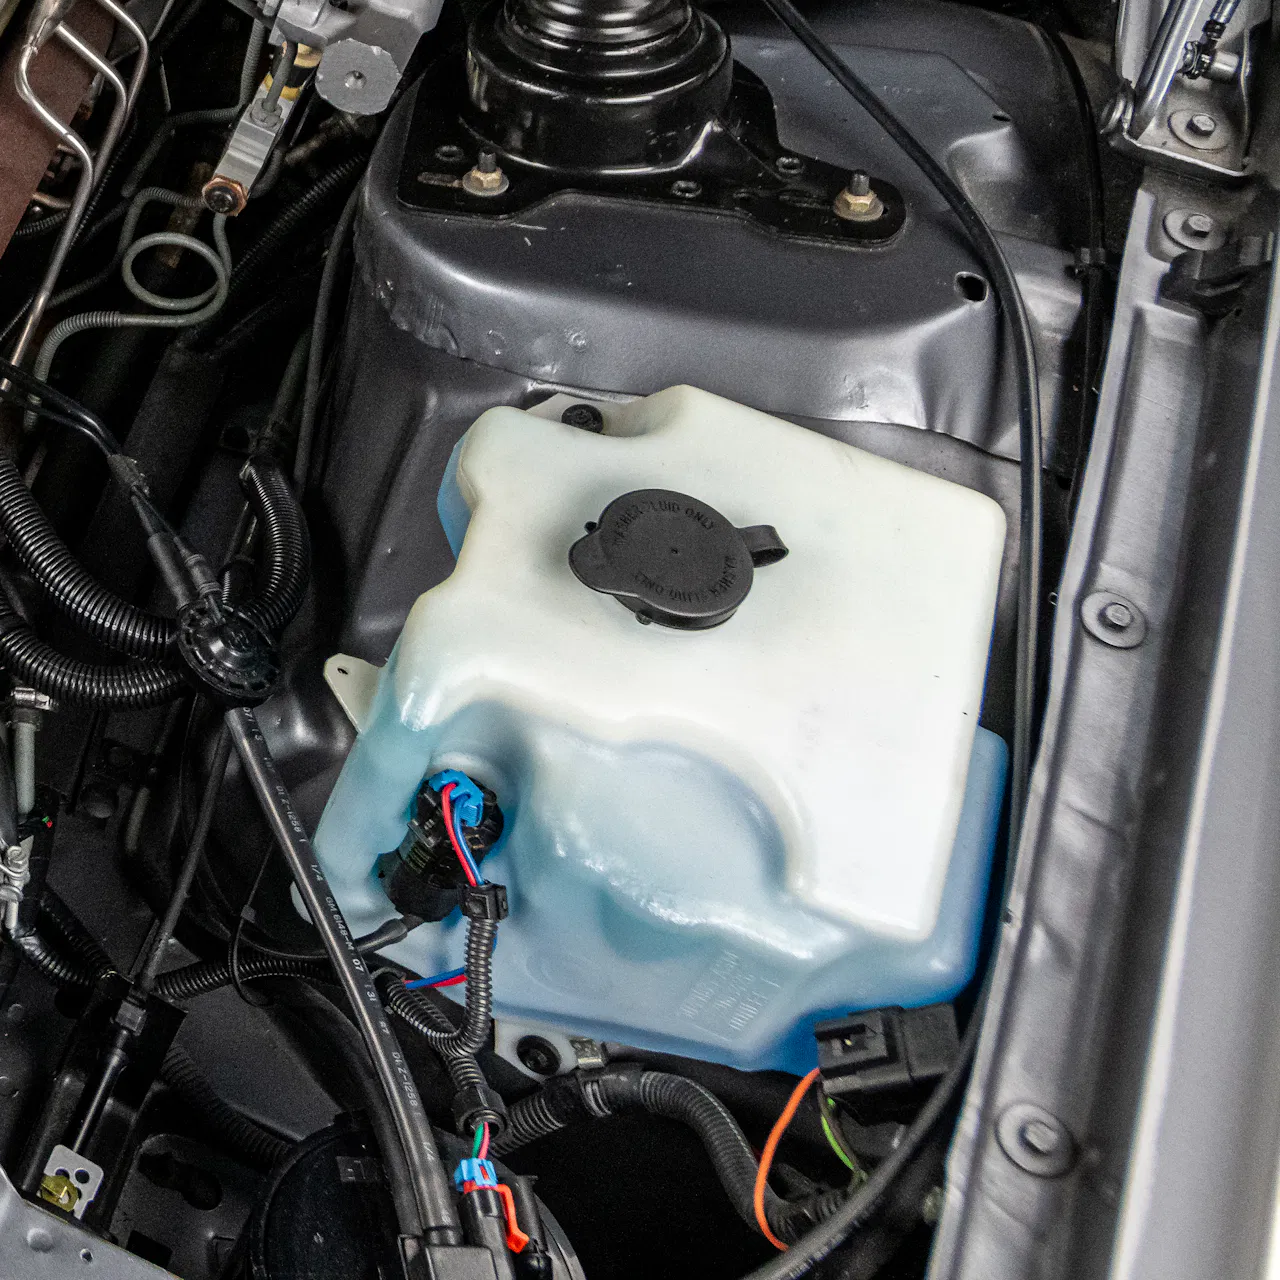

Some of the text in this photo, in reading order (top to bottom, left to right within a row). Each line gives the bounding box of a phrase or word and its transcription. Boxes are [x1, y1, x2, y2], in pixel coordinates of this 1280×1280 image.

[325, 896, 338, 912] GM
[332, 914, 356, 951] 6148-M
[352, 958, 365, 973] 07
